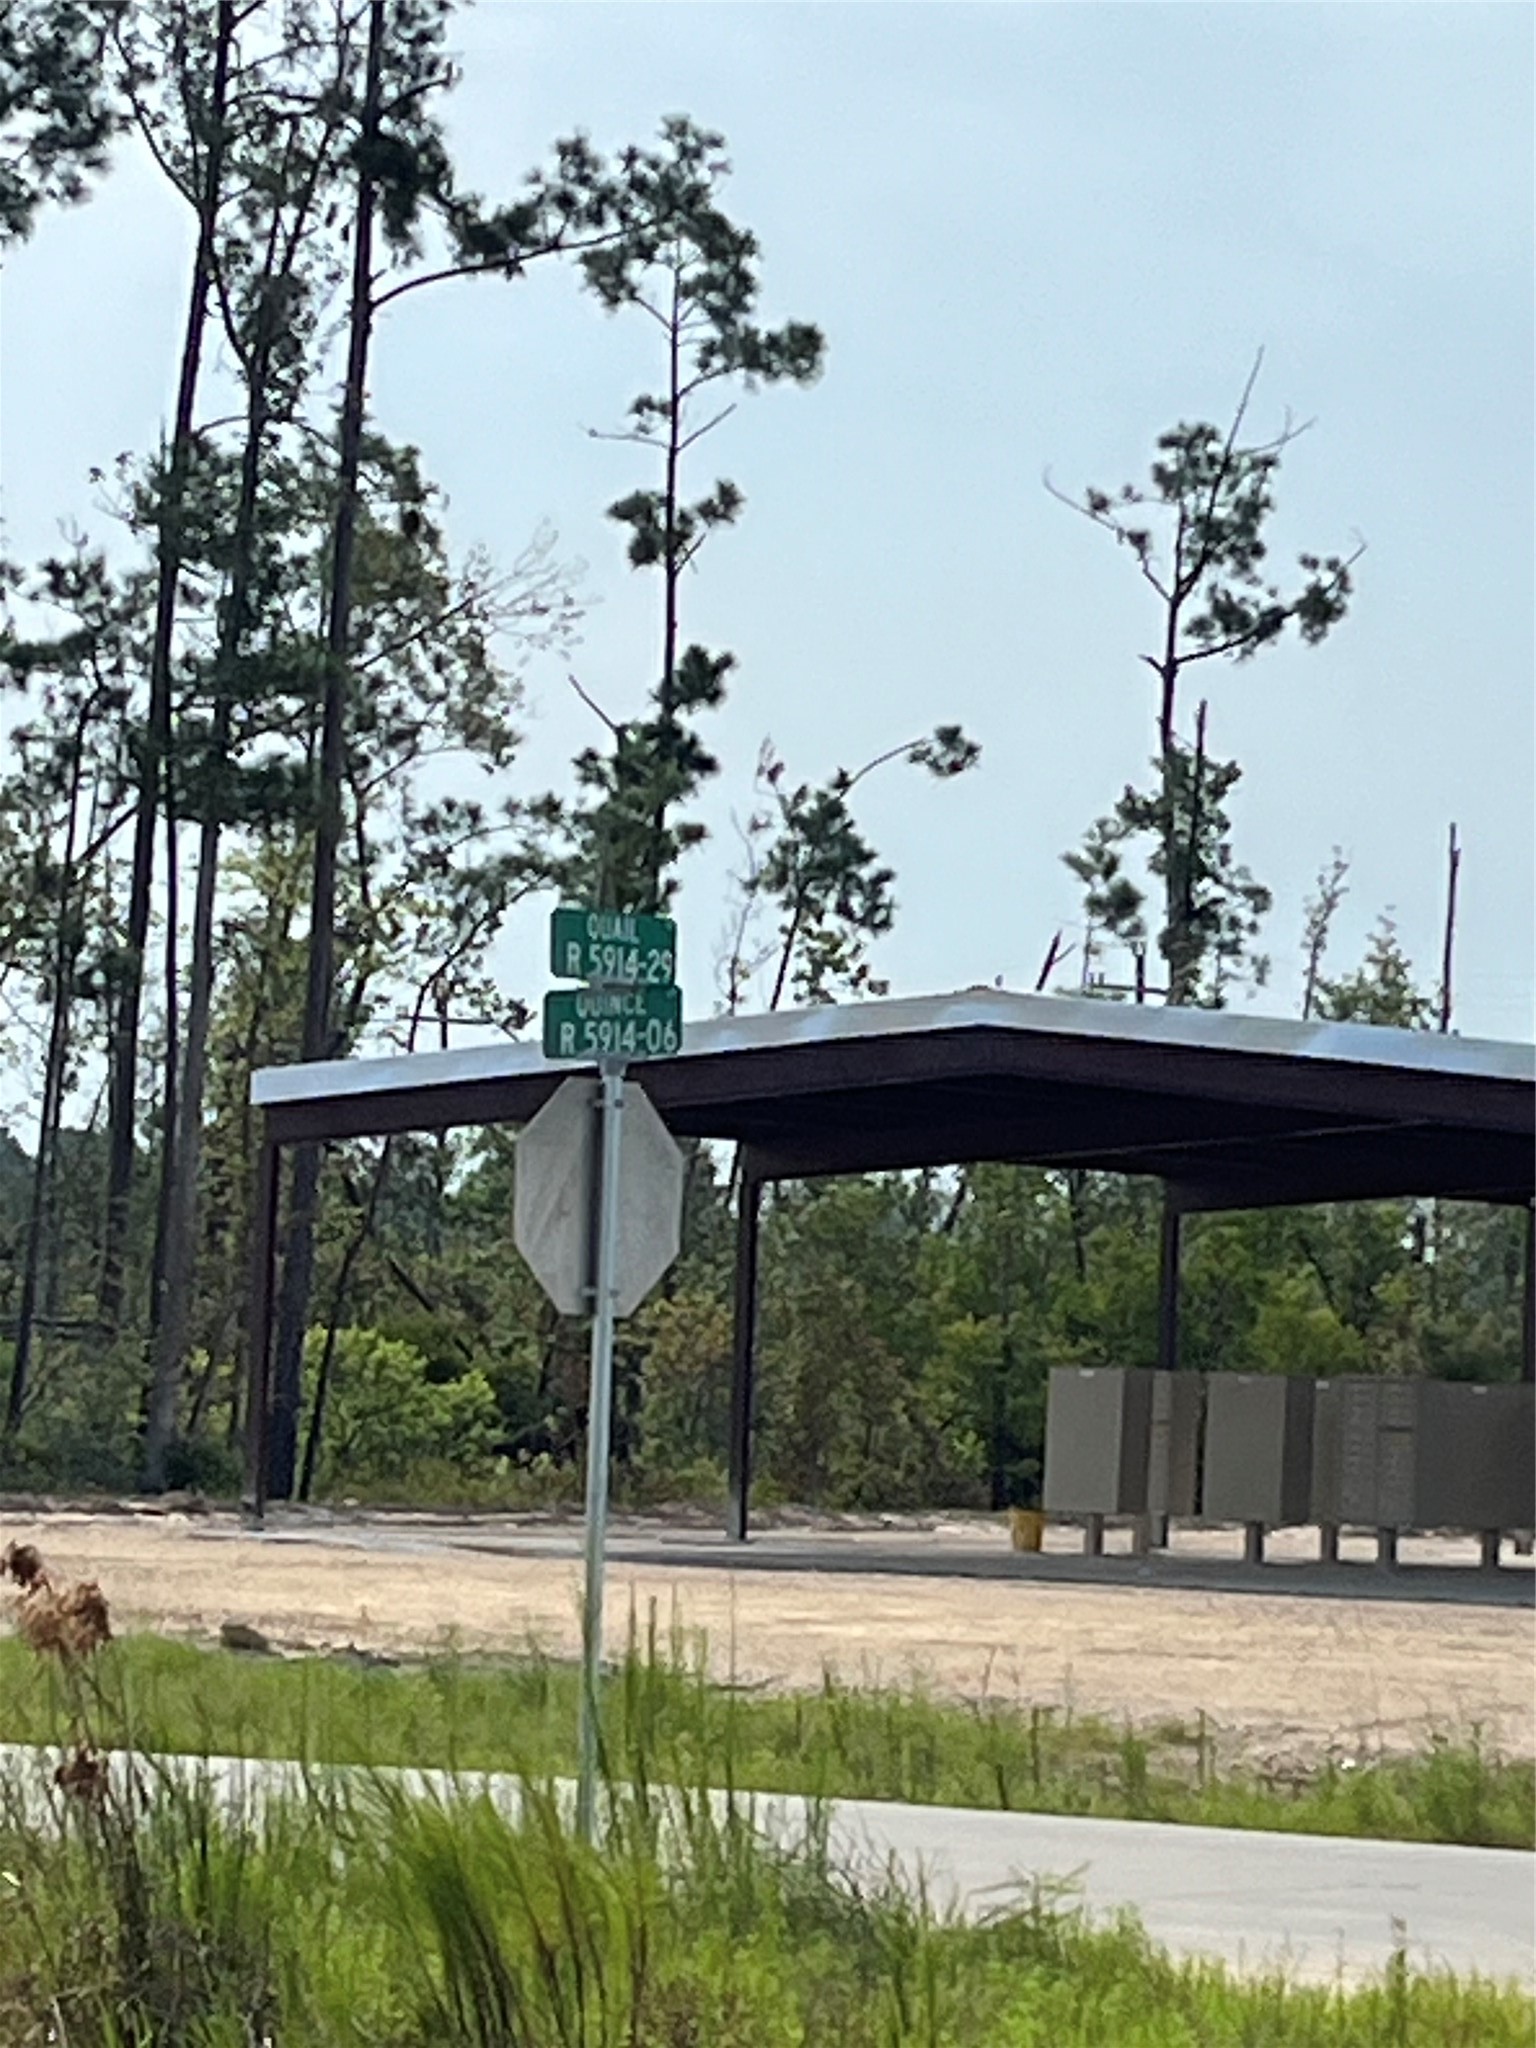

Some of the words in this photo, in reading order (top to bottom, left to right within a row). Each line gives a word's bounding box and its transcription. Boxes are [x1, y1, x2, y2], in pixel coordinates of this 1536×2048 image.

[587, 913, 640, 944] QUAIL
[566, 941, 581, 974] R
[589, 944, 673, 984] 5914-29
[576, 993, 647, 1018] QUINCE
[560, 1022, 575, 1056] R
[584, 1019, 678, 1054] 5914-06
